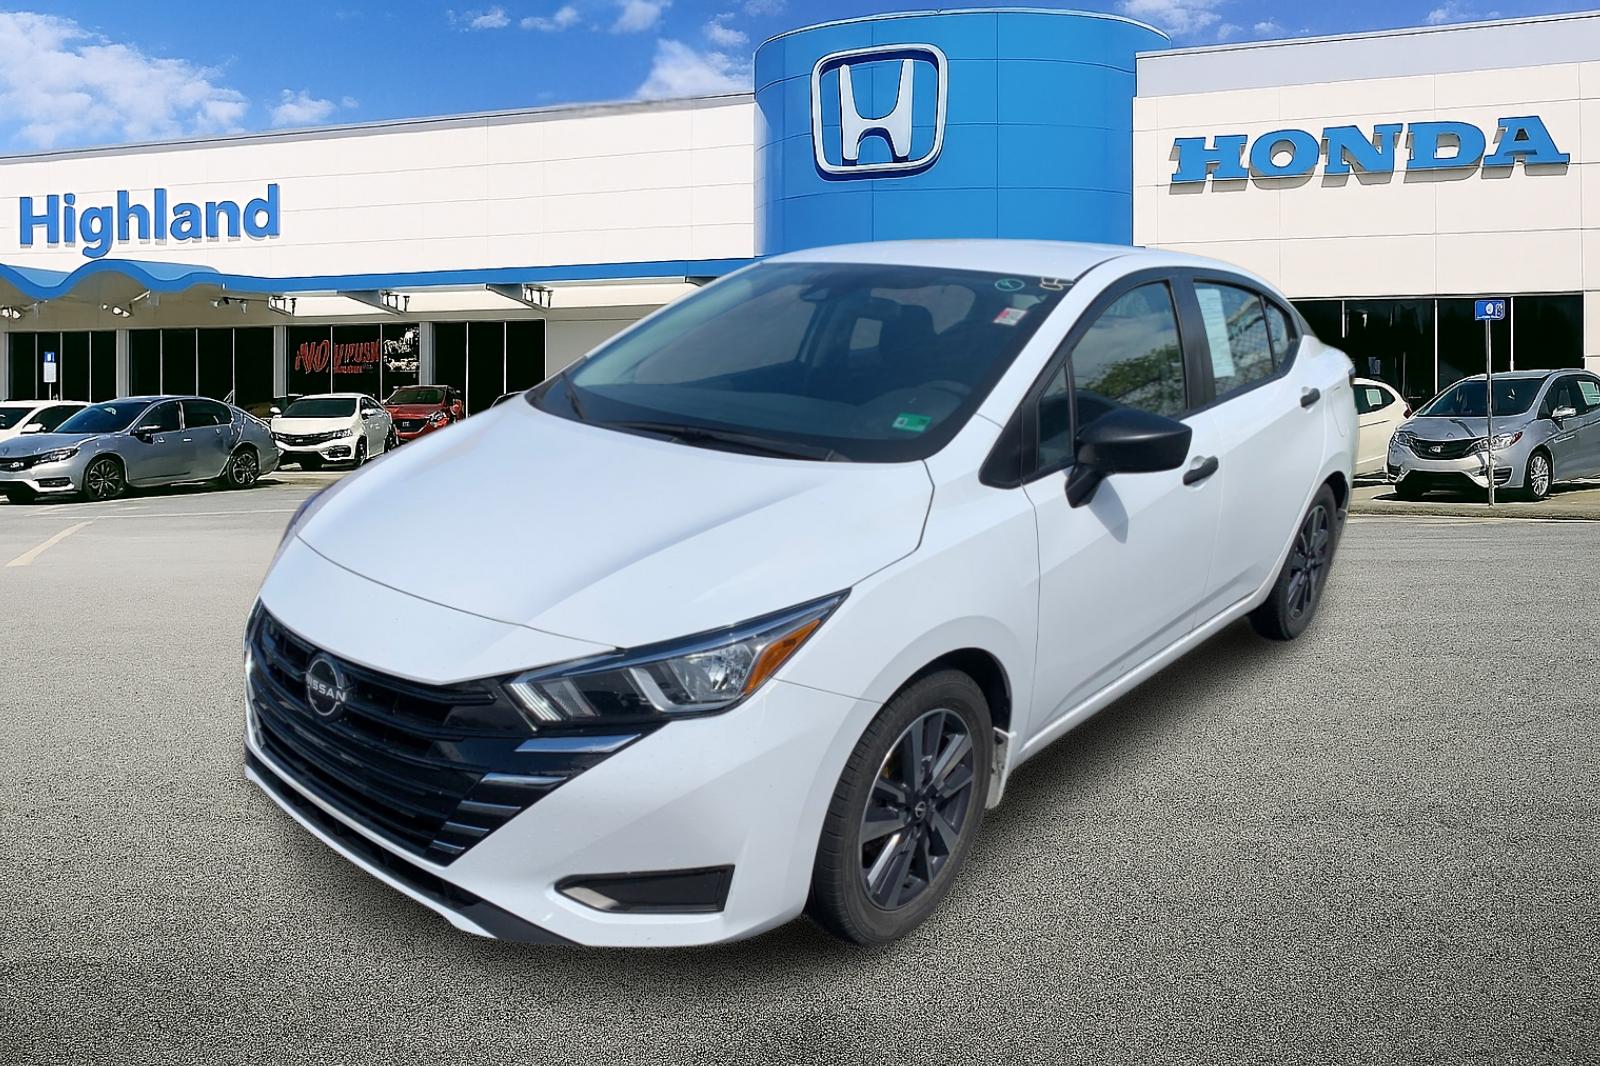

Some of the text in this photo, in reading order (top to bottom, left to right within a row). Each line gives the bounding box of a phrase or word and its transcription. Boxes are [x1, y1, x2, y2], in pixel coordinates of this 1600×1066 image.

[1171, 116, 1571, 184] HONDA
[19, 183, 279, 258] Highland
[306, 672, 346, 702] NISSAN
